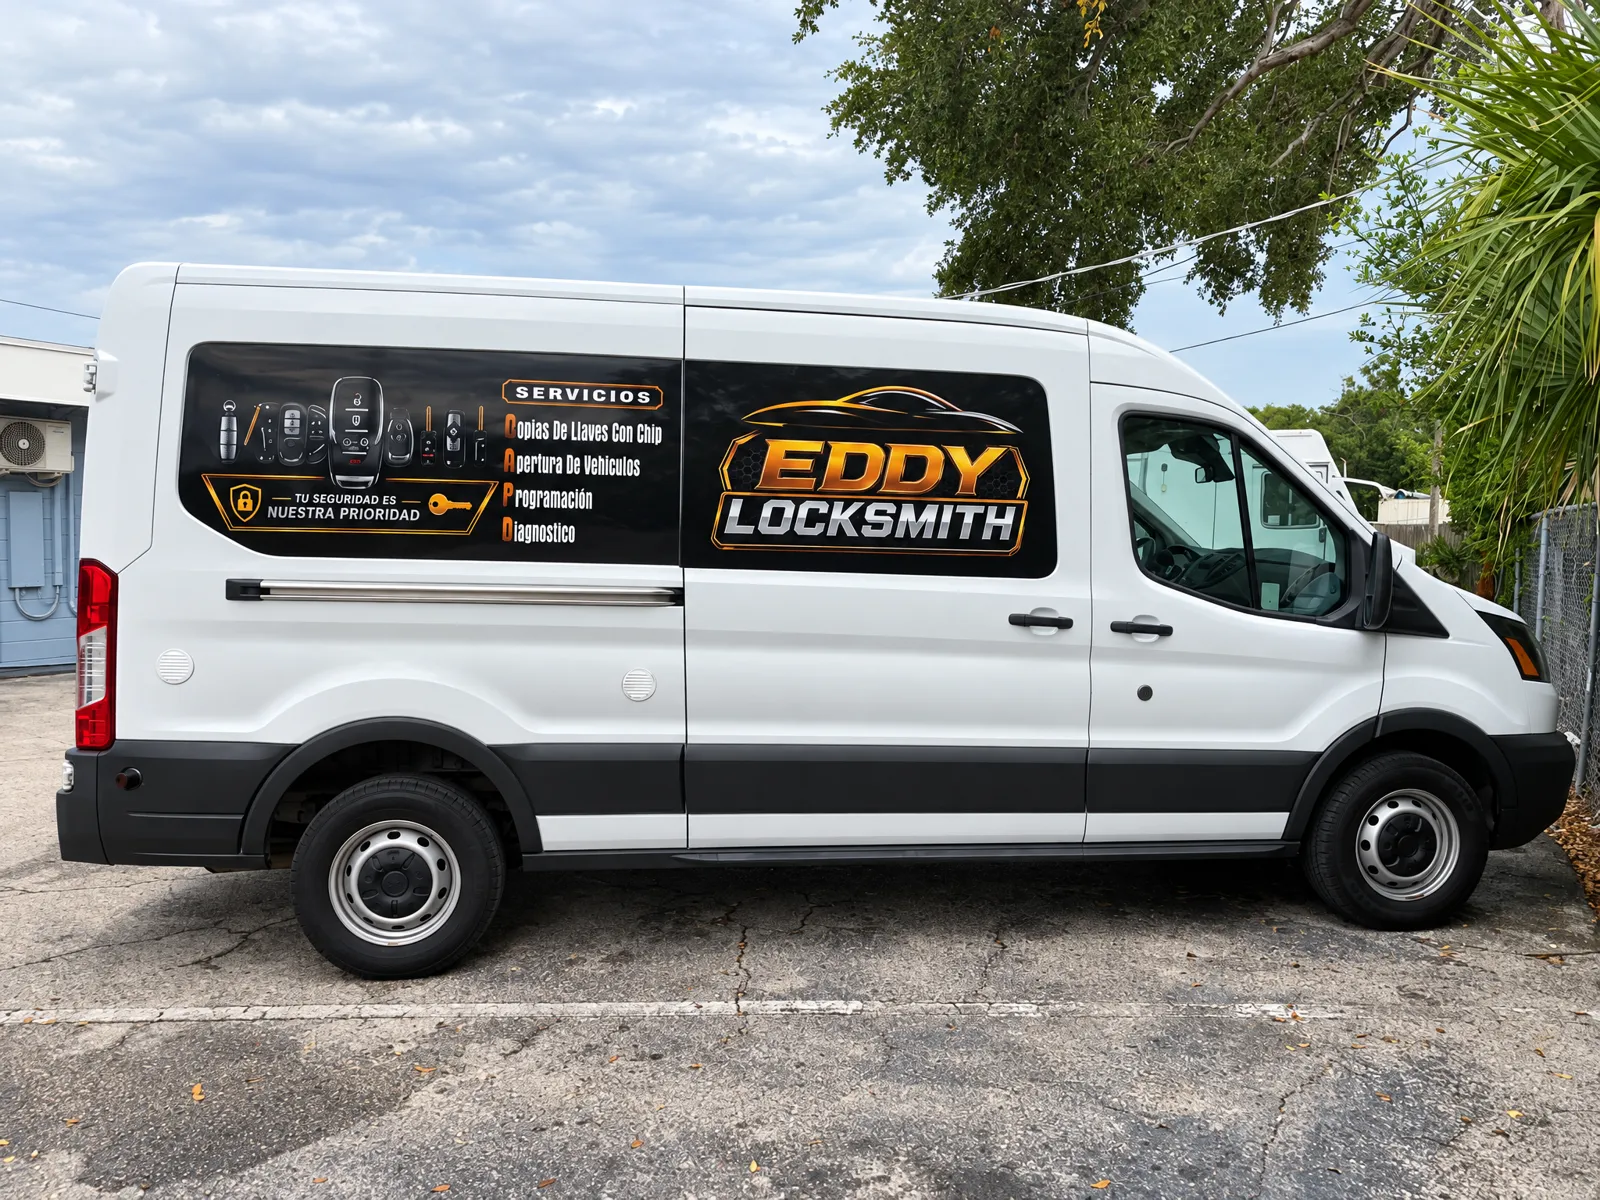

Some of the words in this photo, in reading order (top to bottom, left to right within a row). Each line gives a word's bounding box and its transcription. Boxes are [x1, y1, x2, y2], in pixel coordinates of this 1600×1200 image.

[516, 386, 650, 404] SERVICIOS
[504, 414, 549, 440] Copias
[553, 420, 568, 441] De
[571, 421, 608, 442] Llaves
[612, 422, 634, 443] Con
[637, 423, 662, 445] Chip
[504, 448, 562, 474] Apertura
[566, 454, 580, 475] De
[584, 455, 640, 477] Vehiculos
[754, 438, 1012, 496] EDDY
[295, 494, 310, 504] TU
[312, 494, 378, 505] SEGURIDAD
[382, 496, 396, 505] ES
[502, 482, 593, 510] Programación
[267, 506, 334, 520] NUESTRA
[340, 508, 420, 522] PRIORIDAD
[724, 498, 1016, 541] LOCKSMITH
[502, 516, 576, 544] Diagnostico
